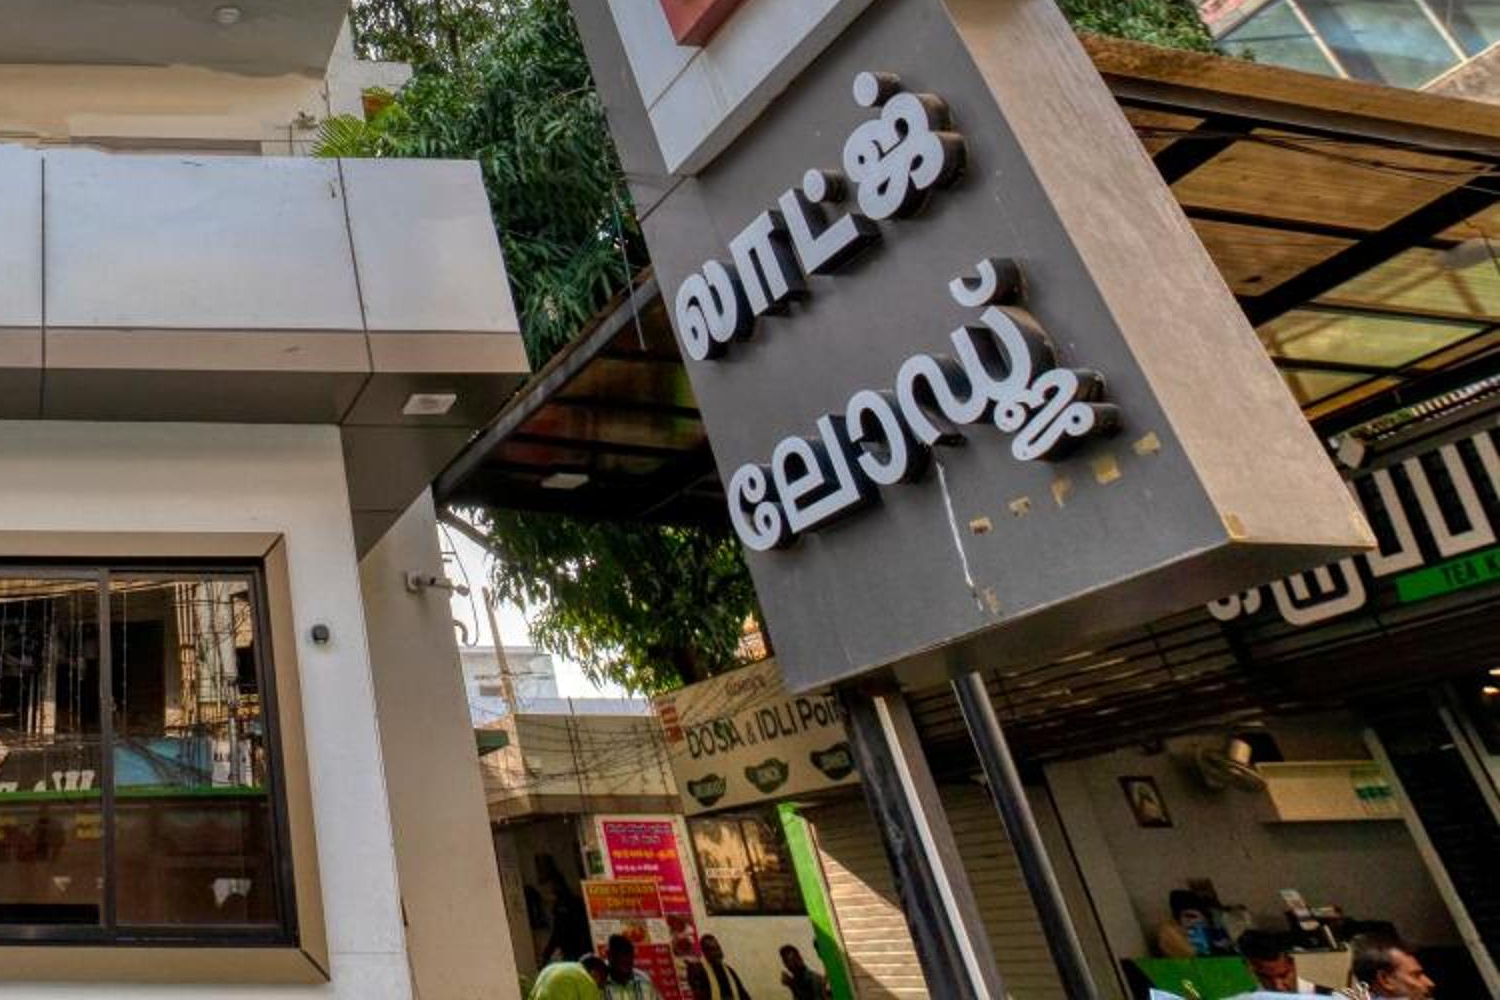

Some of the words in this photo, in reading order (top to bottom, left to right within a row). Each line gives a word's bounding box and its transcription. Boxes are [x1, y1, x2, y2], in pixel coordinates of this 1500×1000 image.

[675, 71, 947, 362] லாட்ஜ்
[1442, 559, 1480, 588] TEA
[684, 716, 746, 760] DOSA
[755, 701, 799, 742] IDLI
